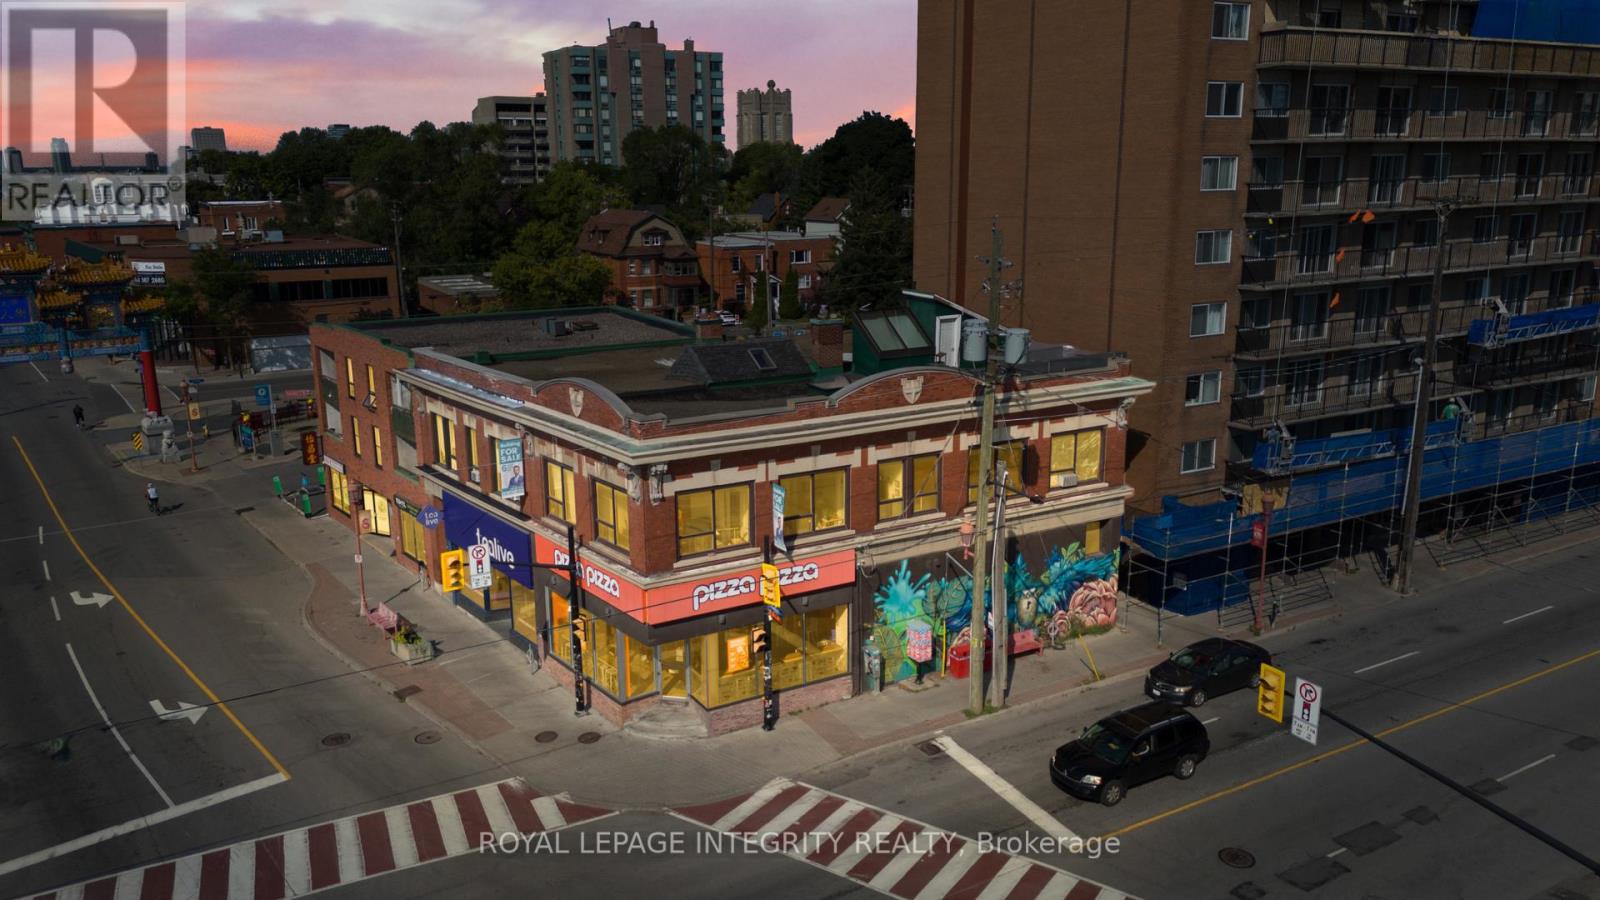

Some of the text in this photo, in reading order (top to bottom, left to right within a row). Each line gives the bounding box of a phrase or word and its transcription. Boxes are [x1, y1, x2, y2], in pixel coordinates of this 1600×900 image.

[500, 447, 518, 456] FOR
[500, 454, 522, 463] SALE
[586, 565, 620, 598] pizza
[692, 575, 756, 611] pizza
